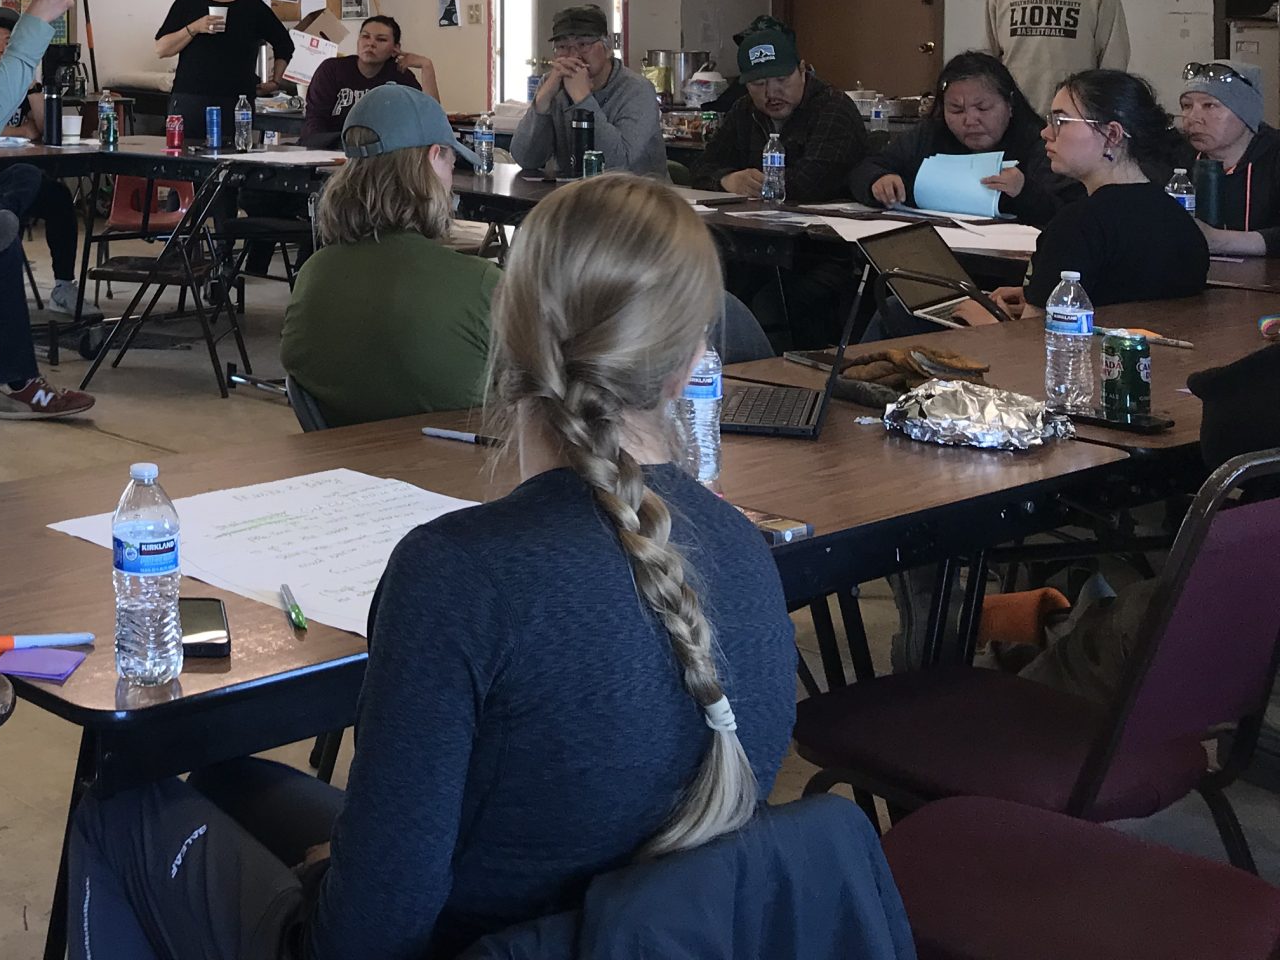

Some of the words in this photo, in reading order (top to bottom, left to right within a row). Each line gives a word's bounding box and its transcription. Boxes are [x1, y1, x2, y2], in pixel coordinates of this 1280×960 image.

[1009, 5, 1081, 29] LIONS
[1016, 27, 1065, 36] BASKETBALL
[141, 540, 176, 552] KIRKLAND
[171, 824, 208, 879] BALEAF
